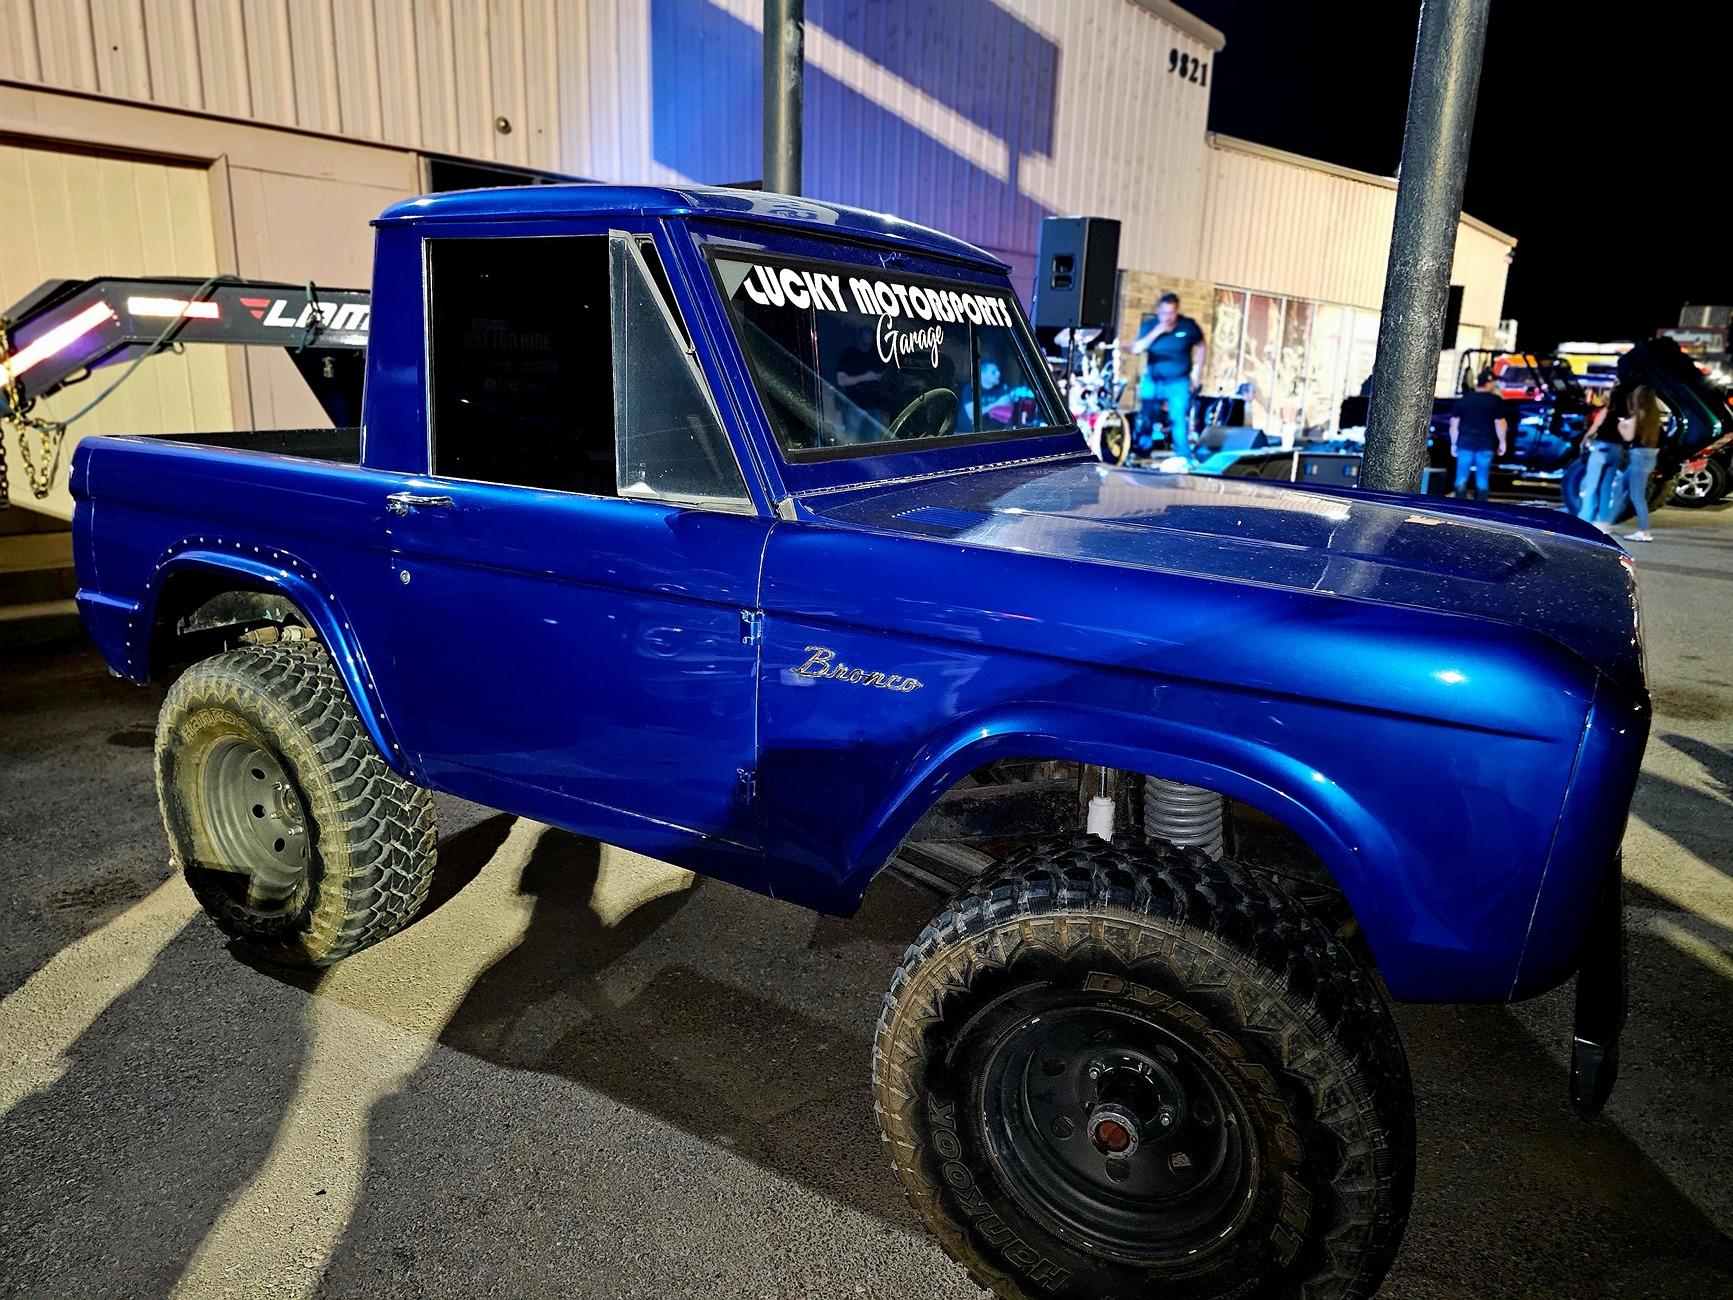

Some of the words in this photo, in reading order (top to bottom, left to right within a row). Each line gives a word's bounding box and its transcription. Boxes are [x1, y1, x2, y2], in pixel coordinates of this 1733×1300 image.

[1167, 48, 1208, 87] 9821
[743, 264, 849, 312] LUCKY
[848, 276, 1013, 328] MOTORSPORTS
[876, 312, 944, 369] Garage
[789, 645, 925, 693] Bronco
